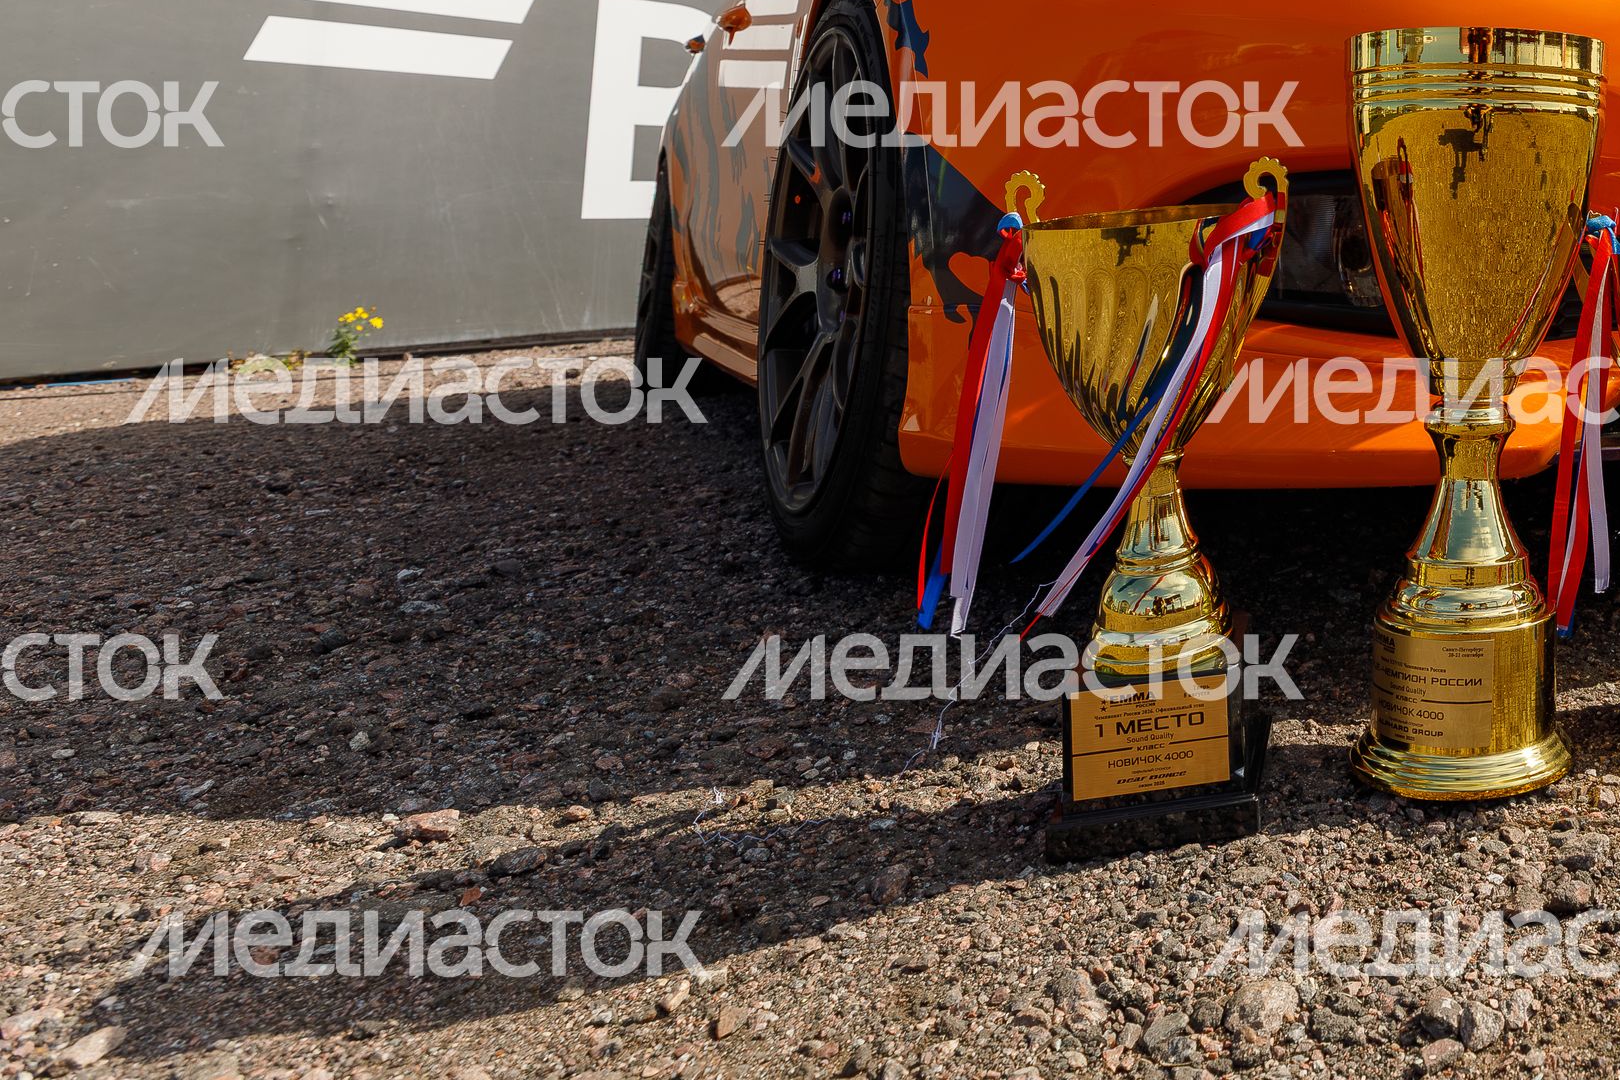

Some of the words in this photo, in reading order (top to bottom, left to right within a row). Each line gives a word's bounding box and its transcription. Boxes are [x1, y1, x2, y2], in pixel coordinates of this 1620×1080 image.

[1431, 677, 1482, 686] РОССИИ
[1405, 685, 1427, 697] Quality
[1109, 691, 1157, 705] EMMA
[1416, 710, 1444, 720] 4000
[1094, 724, 1104, 738] 1
[1116, 711, 1205, 736] МЕСТО
[1127, 734, 1149, 744] Sound
[1150, 732, 1175, 742] Quality
[1412, 728, 1443, 737] GROUP
[1136, 743, 1166, 752] класс
[1108, 753, 1163, 769] НОВИЧОК
[1164, 750, 1194, 761] 4000
